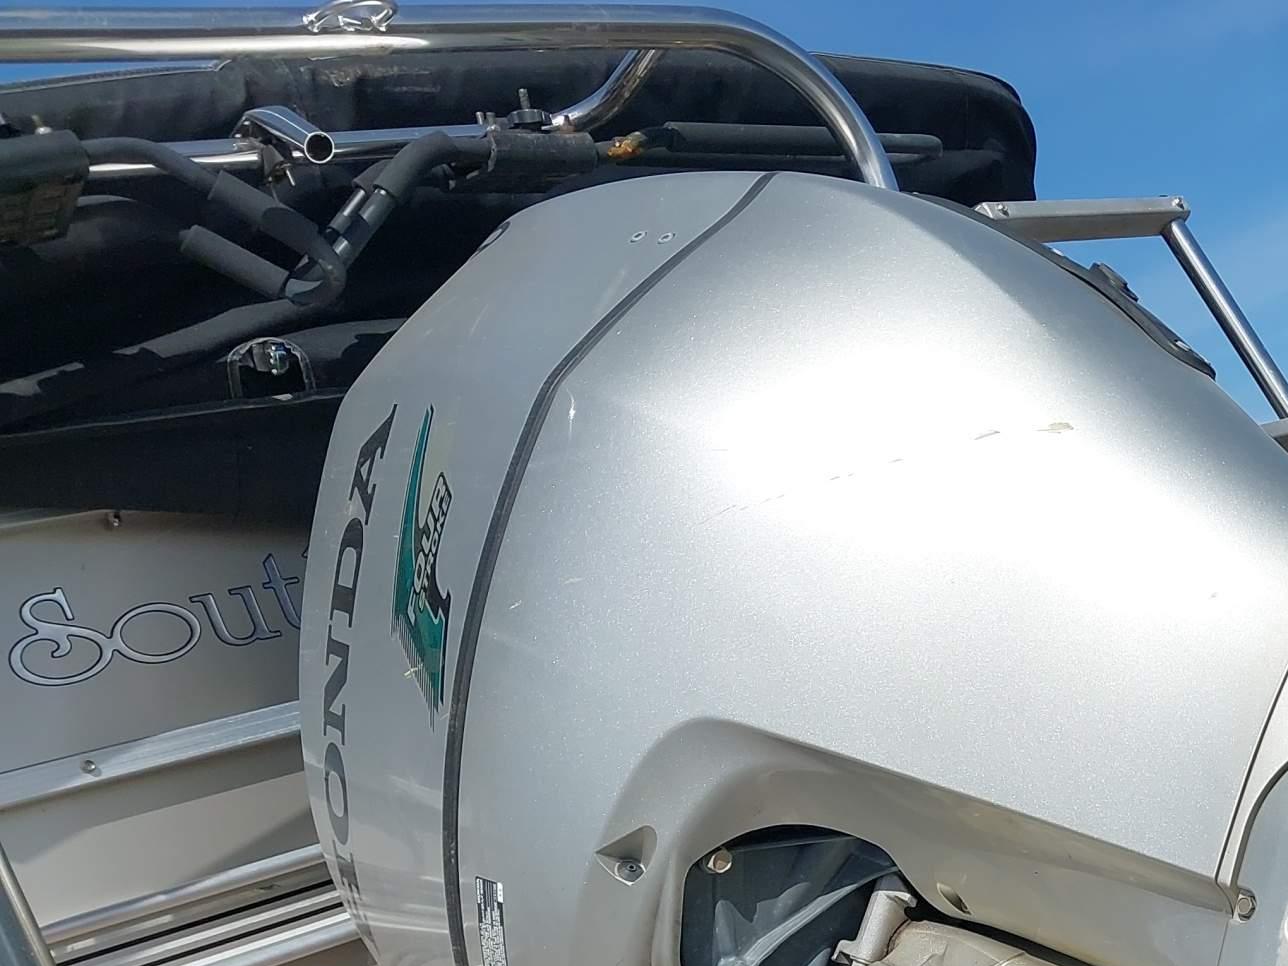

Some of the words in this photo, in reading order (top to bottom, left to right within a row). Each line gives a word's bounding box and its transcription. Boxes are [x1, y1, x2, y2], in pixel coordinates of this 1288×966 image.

[8, 546, 308, 688] Sout
[407, 475, 446, 627] FOUR
[418, 488, 452, 613] STROKE
[322, 403, 398, 950] HONDA
